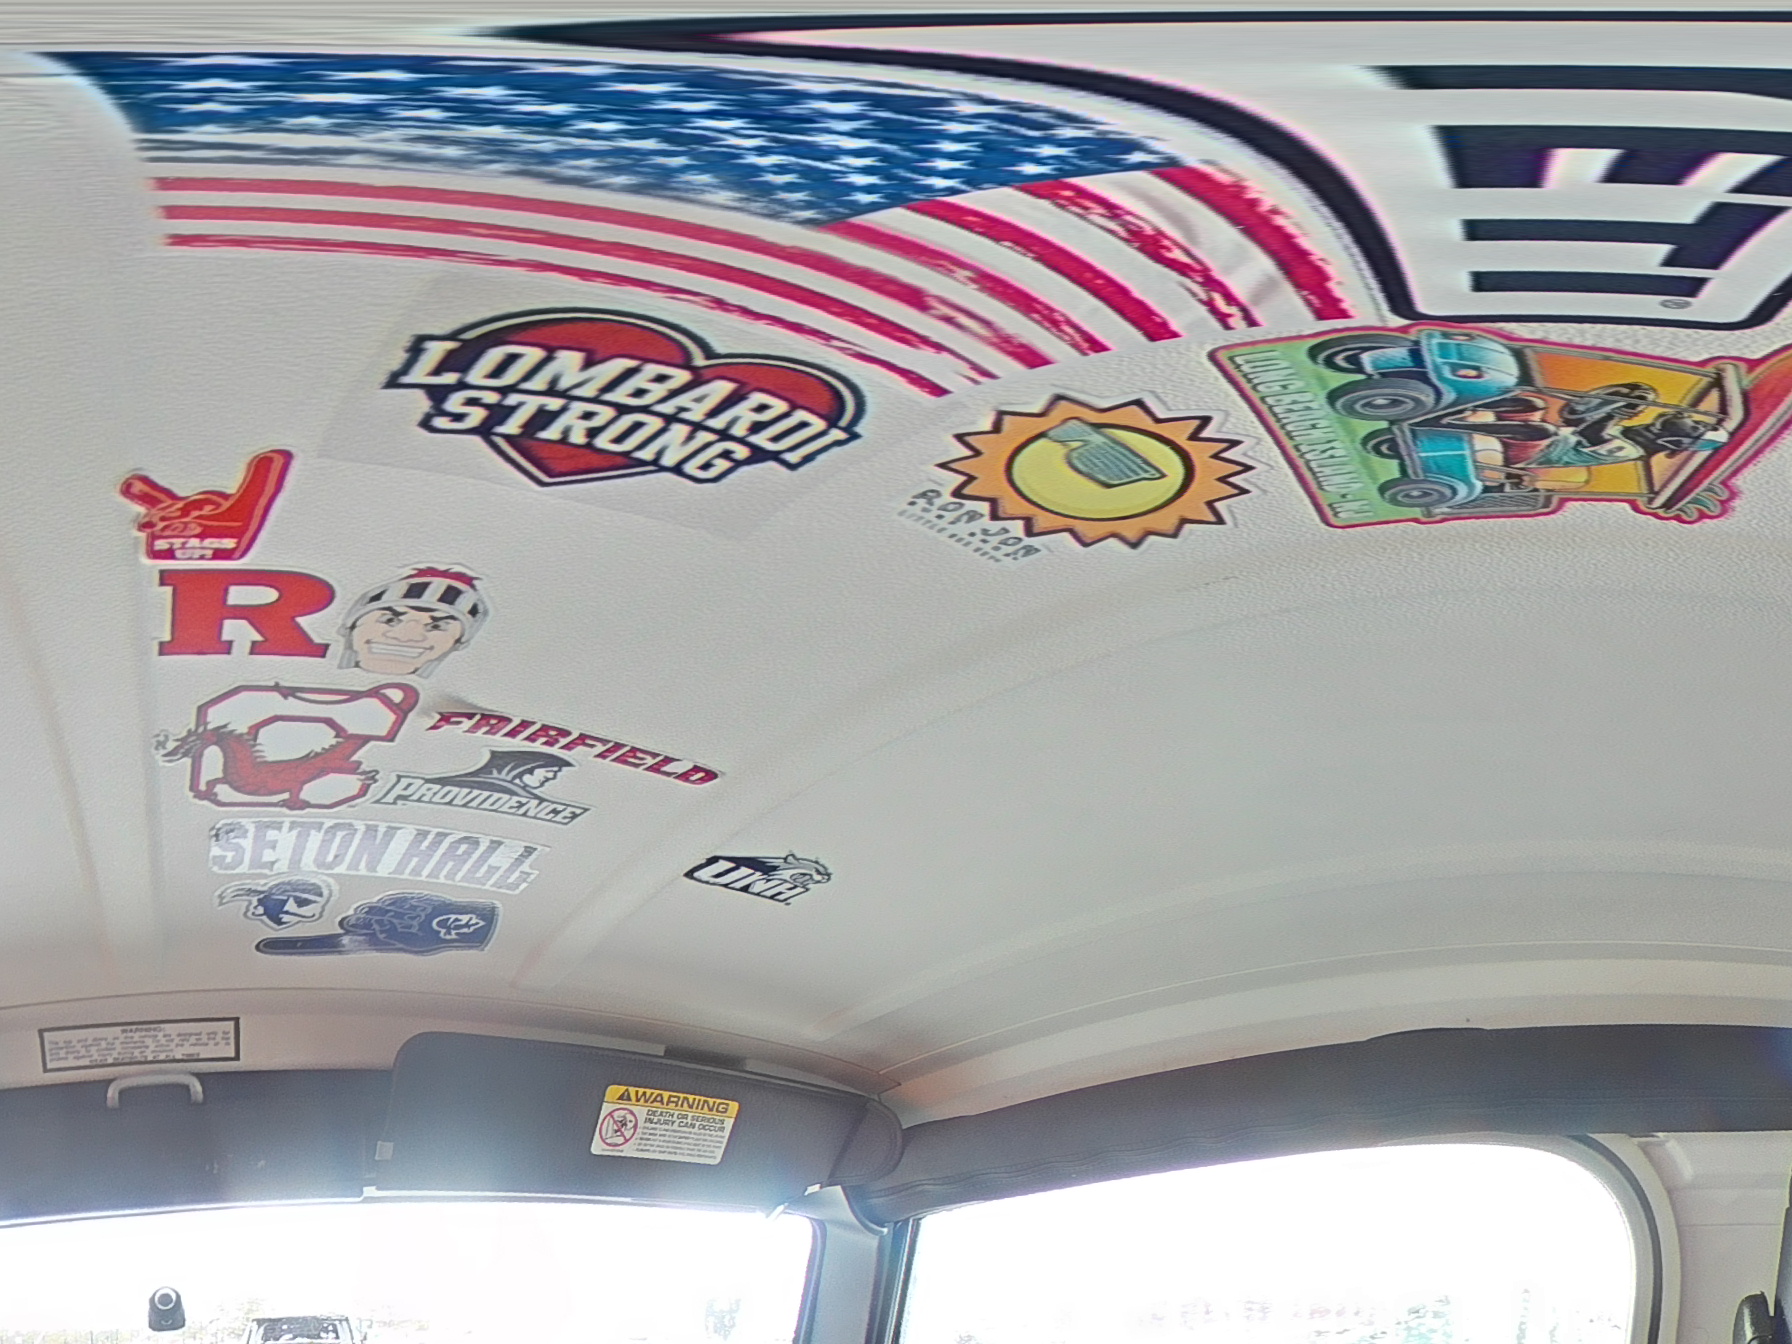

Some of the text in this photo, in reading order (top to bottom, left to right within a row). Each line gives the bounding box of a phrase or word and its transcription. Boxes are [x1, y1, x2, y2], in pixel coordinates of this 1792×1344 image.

[1229, 349, 1307, 392] LONG
[400, 339, 849, 463] LOMBARDI
[1262, 391, 1337, 440] BEACH
[432, 389, 752, 480] STRONG
[1295, 439, 1365, 492] ISLAND
[153, 537, 239, 551] STAGS
[912, 488, 984, 525] RON
[981, 526, 1042, 558] JON
[158, 568, 335, 658] R
[426, 711, 719, 786] FAIRFIELD
[387, 775, 583, 824] PROVIDENCE
[210, 819, 538, 890] SETON HALL
[692, 859, 807, 901] UNH
[635, 1089, 731, 1115] WARNING
[644, 1117, 726, 1134] INJURY CAN OCCUR
[646, 1108, 726, 1125] DEATH OR SERIOUS
